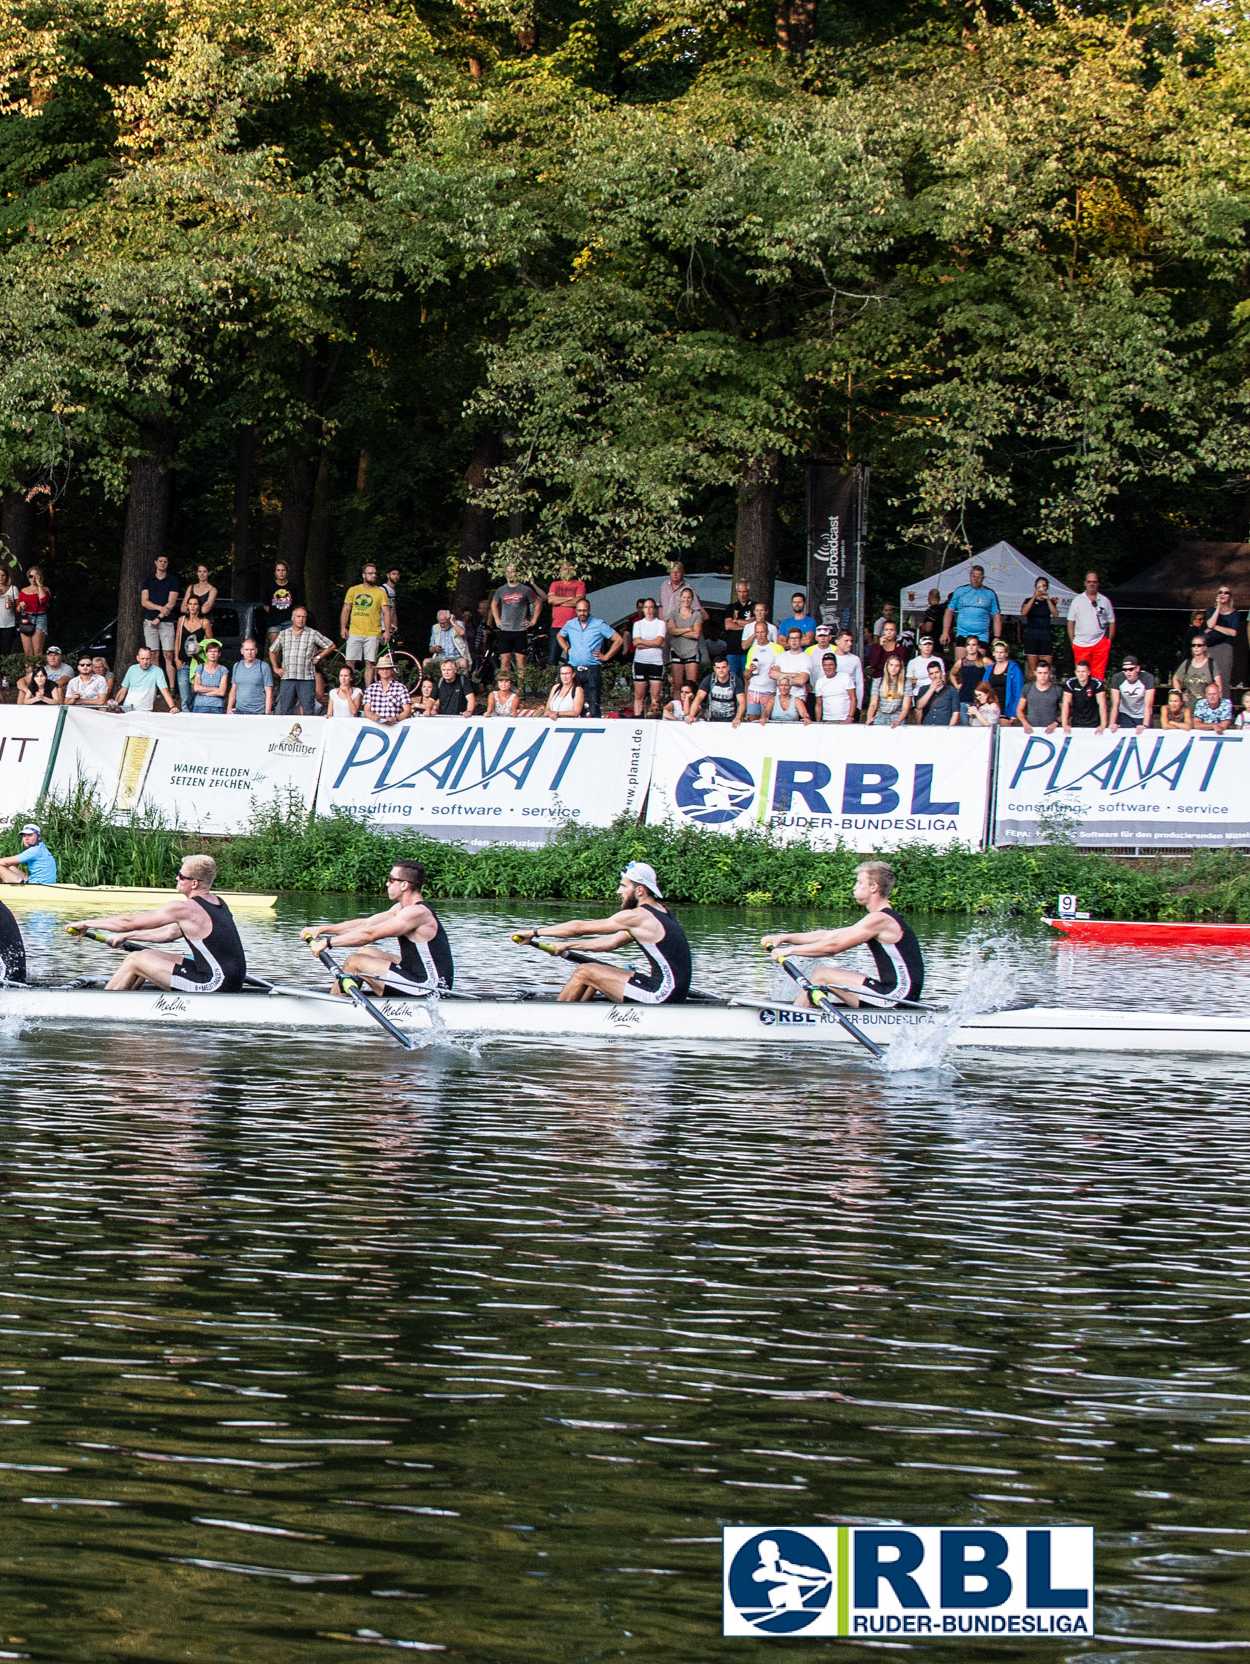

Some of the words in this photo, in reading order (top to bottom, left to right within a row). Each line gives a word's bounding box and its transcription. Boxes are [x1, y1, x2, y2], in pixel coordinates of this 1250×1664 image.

[827, 515, 840, 577] Broadcast
[827, 579, 839, 601] Live
[332, 725, 607, 796] PLANAT
[625, 728, 643, 809] ww.planat.de
[1008, 735, 1244, 796] PLANAT
[173, 763, 209, 776] WAHRE
[212, 766, 250, 778] HELDEN
[170, 775, 206, 787] SETZEN
[209, 778, 254, 791] ZEICHEN.
[772, 760, 960, 816] RBL
[431, 804, 502, 816] software
[522, 806, 581, 818] service
[1098, 802, 1160, 814] software
[1177, 803, 1229, 815] service
[771, 815, 959, 831] RUDER-BUNDESLIGA
[470, 838, 489, 847] den
[1080, 830, 1119, 838] Software
[1121, 830, 1134, 838] für
[1154, 831, 1223, 840] produzierenden
[1062, 896, 1072, 910] 9
[150, 993, 188, 1013] Melitta
[379, 996, 413, 1018] Melitta
[605, 1004, 642, 1024] Melitta
[779, 1009, 816, 1023] RBL
